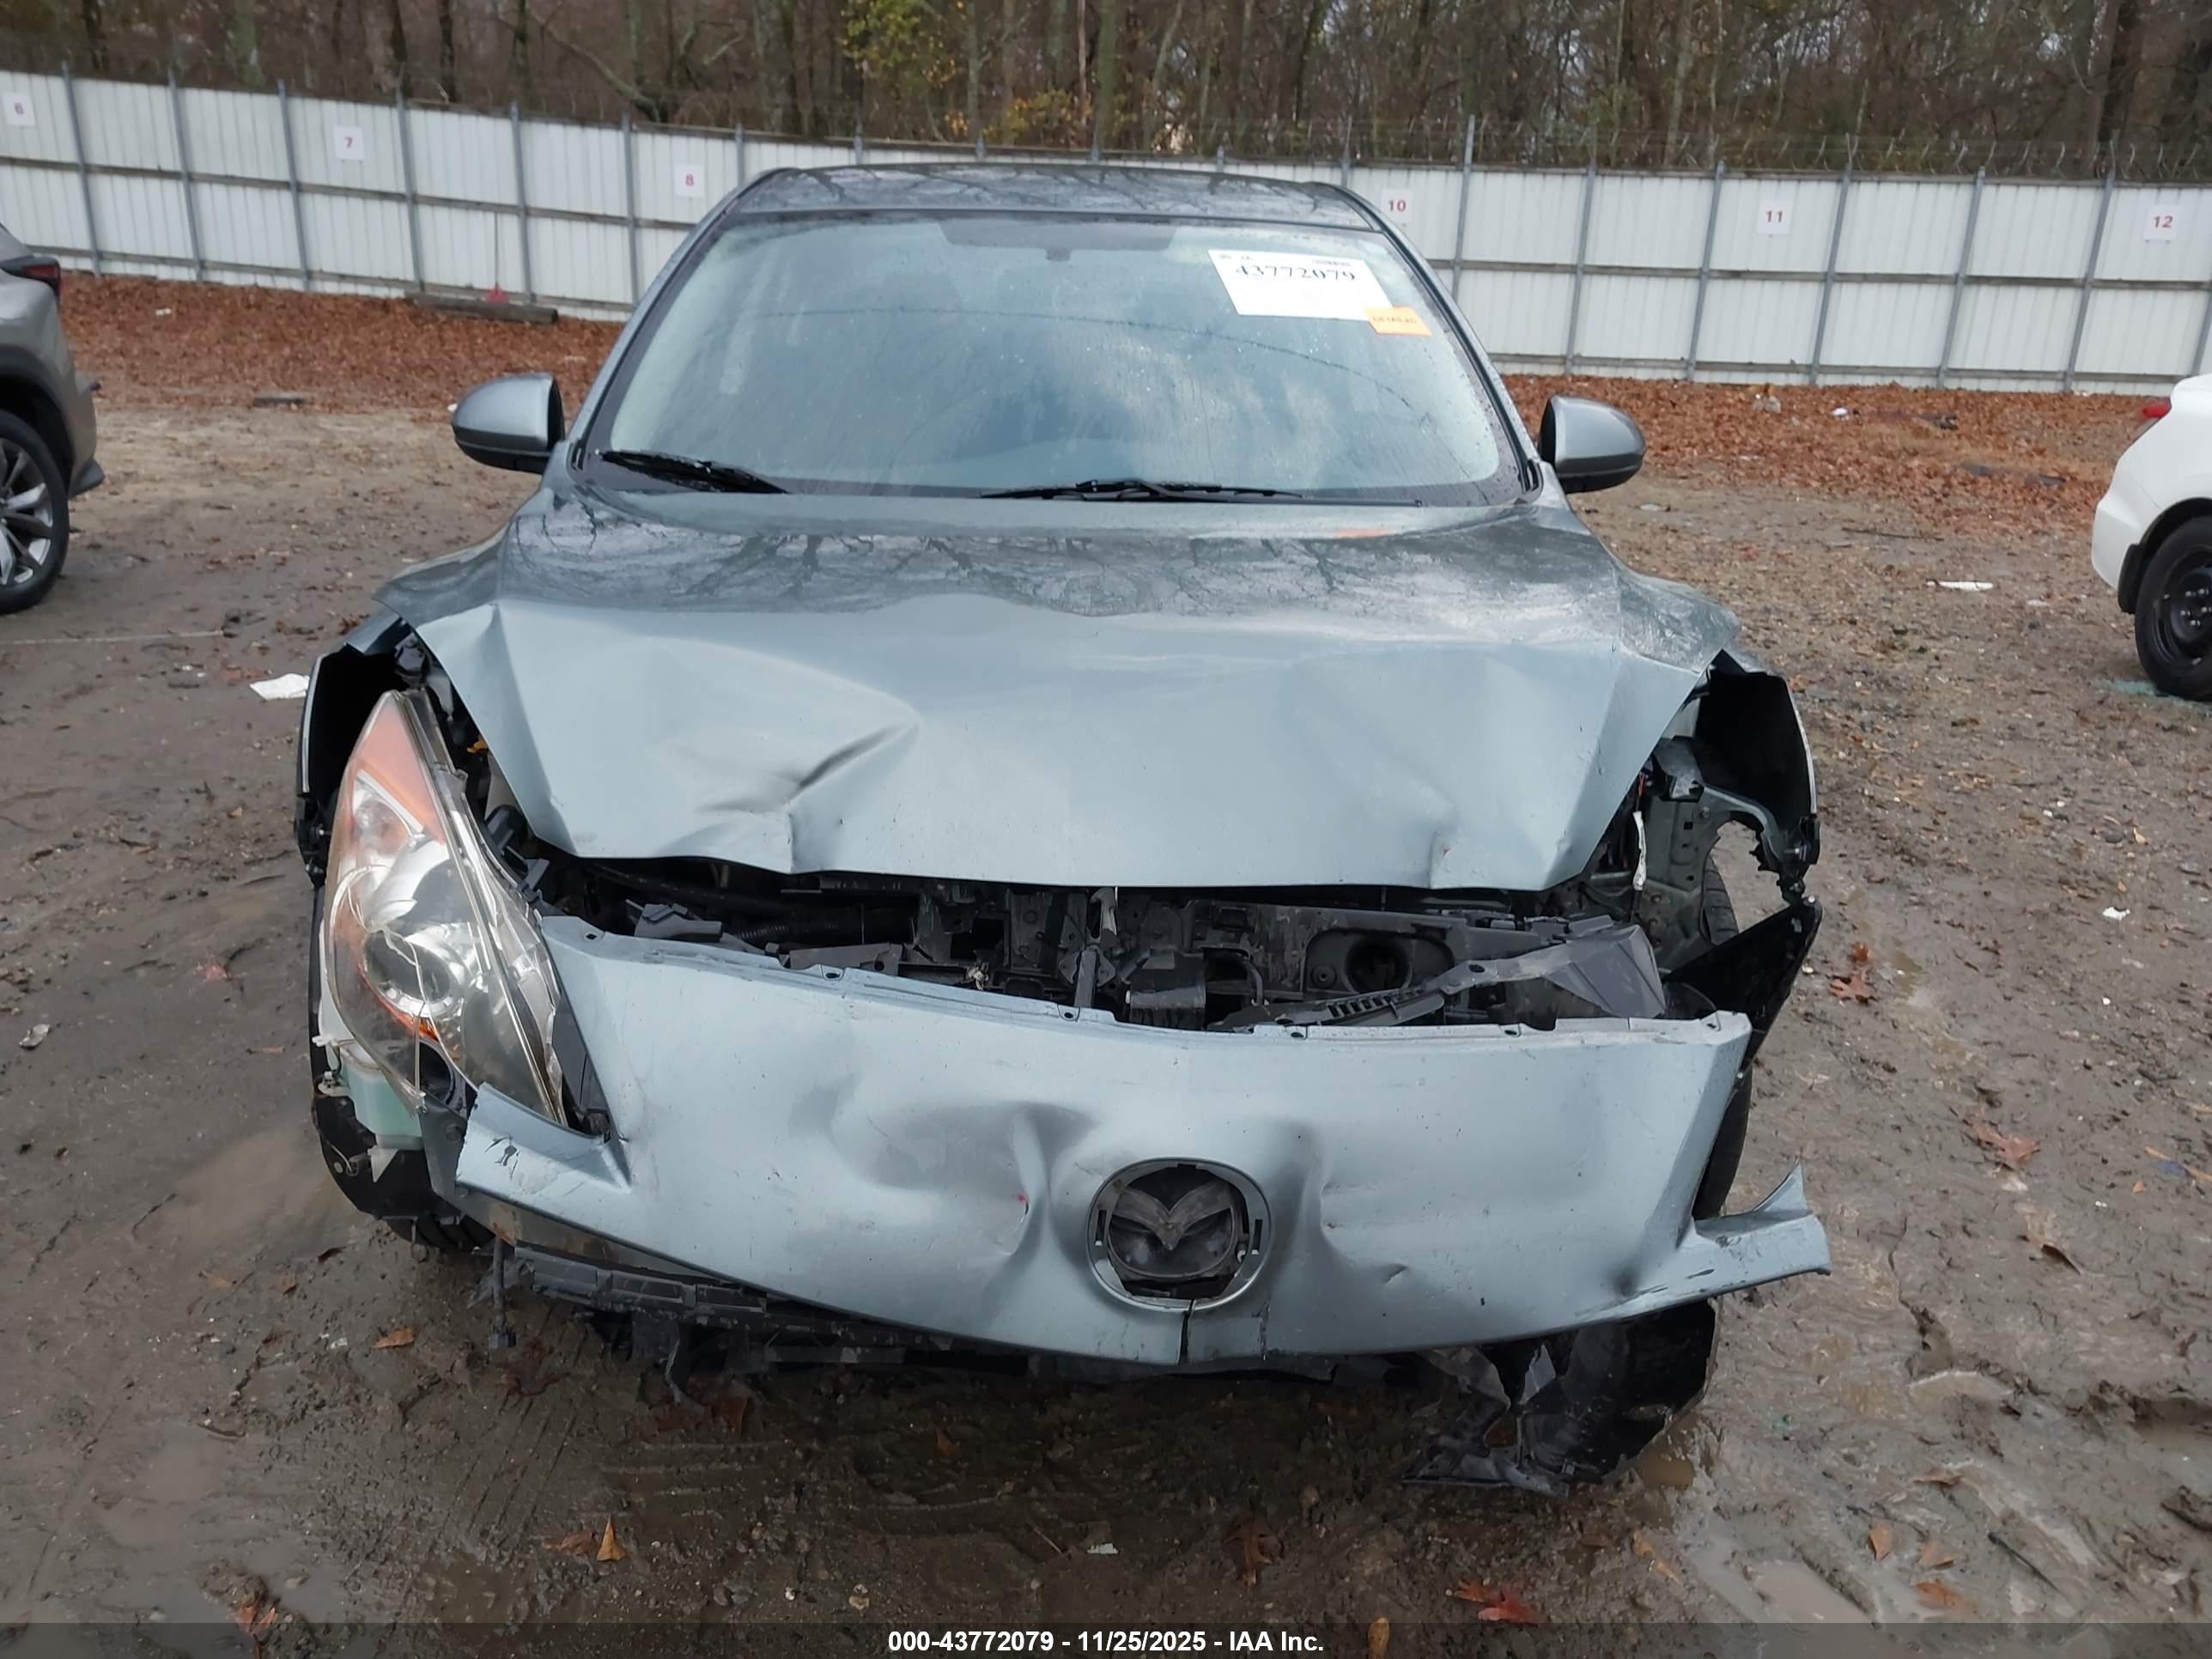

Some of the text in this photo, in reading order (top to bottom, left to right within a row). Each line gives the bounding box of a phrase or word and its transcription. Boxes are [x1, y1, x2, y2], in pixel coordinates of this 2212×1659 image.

[15, 102, 24, 115] 6
[344, 137, 354, 149] 7
[685, 173, 695, 187] 8
[1389, 198, 1407, 212] 10
[1765, 210, 1784, 222] 11
[2154, 215, 2172, 228] 12
[1235, 264, 1357, 282] 43772079
